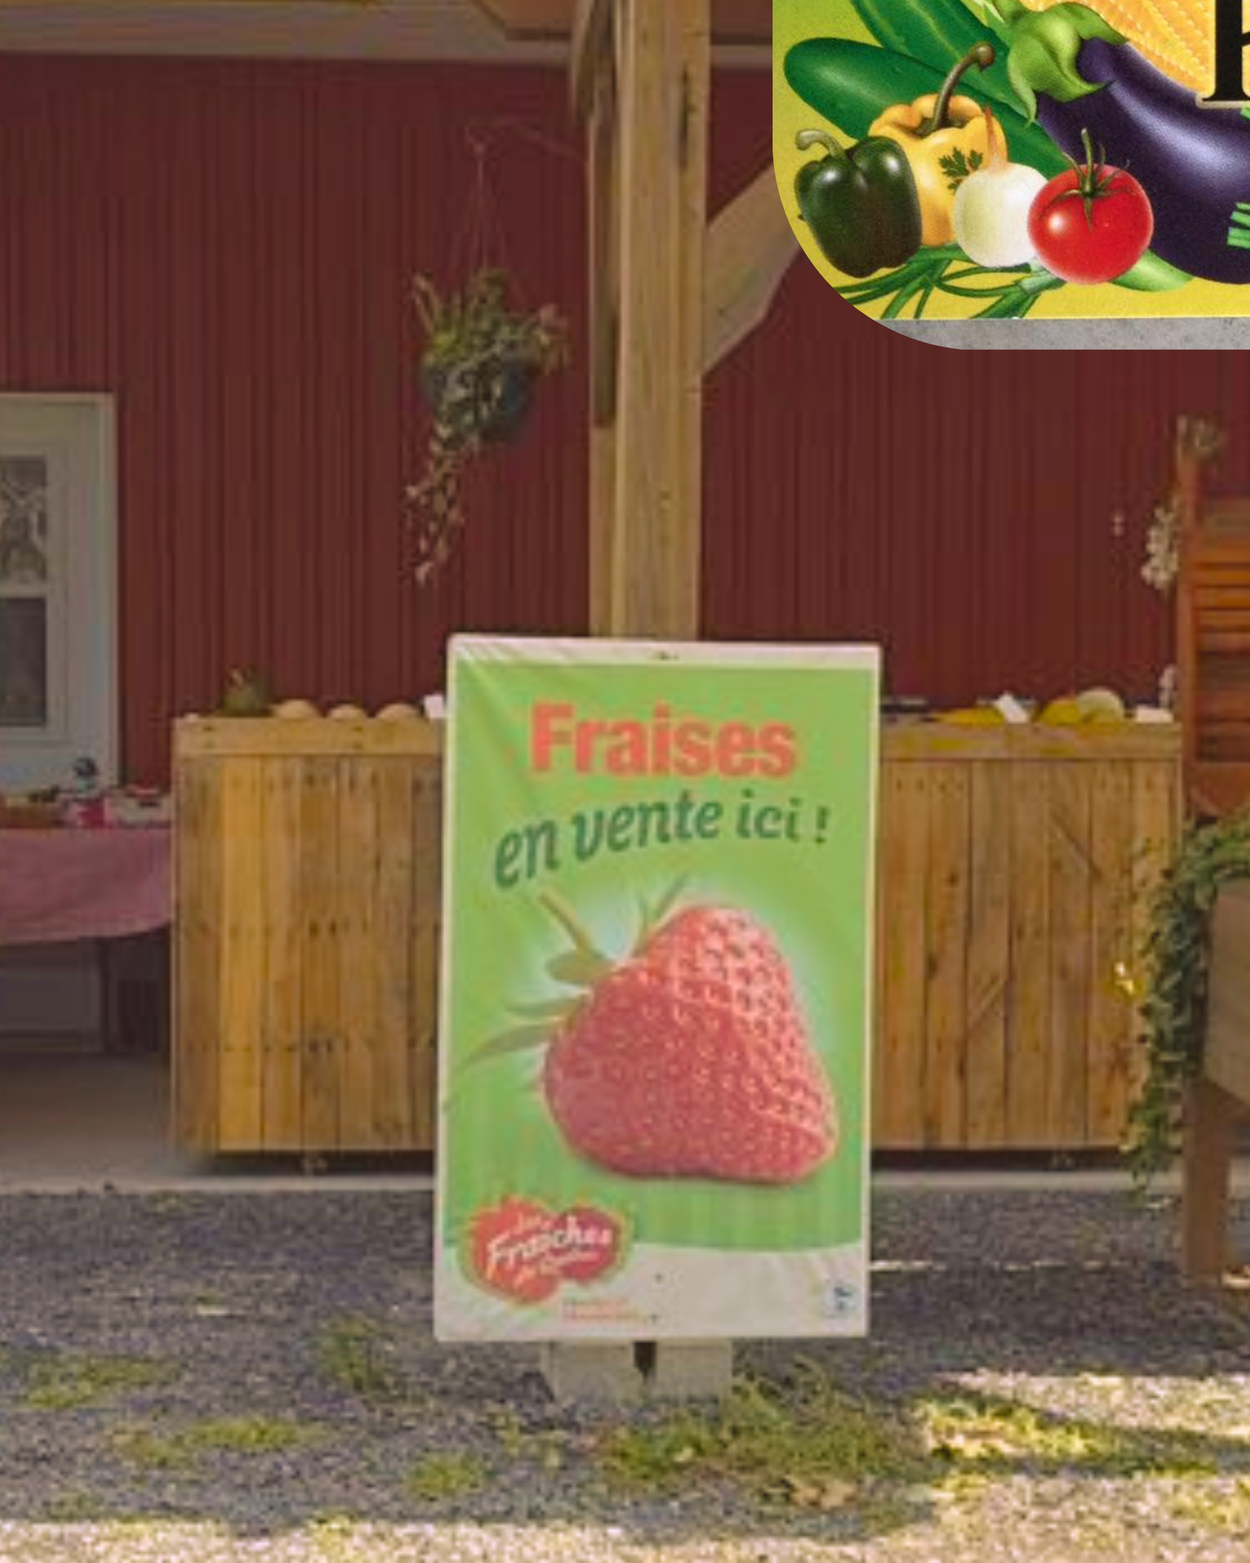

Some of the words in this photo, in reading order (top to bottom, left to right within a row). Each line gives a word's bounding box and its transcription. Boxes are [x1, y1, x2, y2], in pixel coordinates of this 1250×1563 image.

[530, 702, 797, 777] Fraises
[494, 818, 561, 890] en
[571, 789, 724, 863] vente
[735, 788, 801, 842] ici
